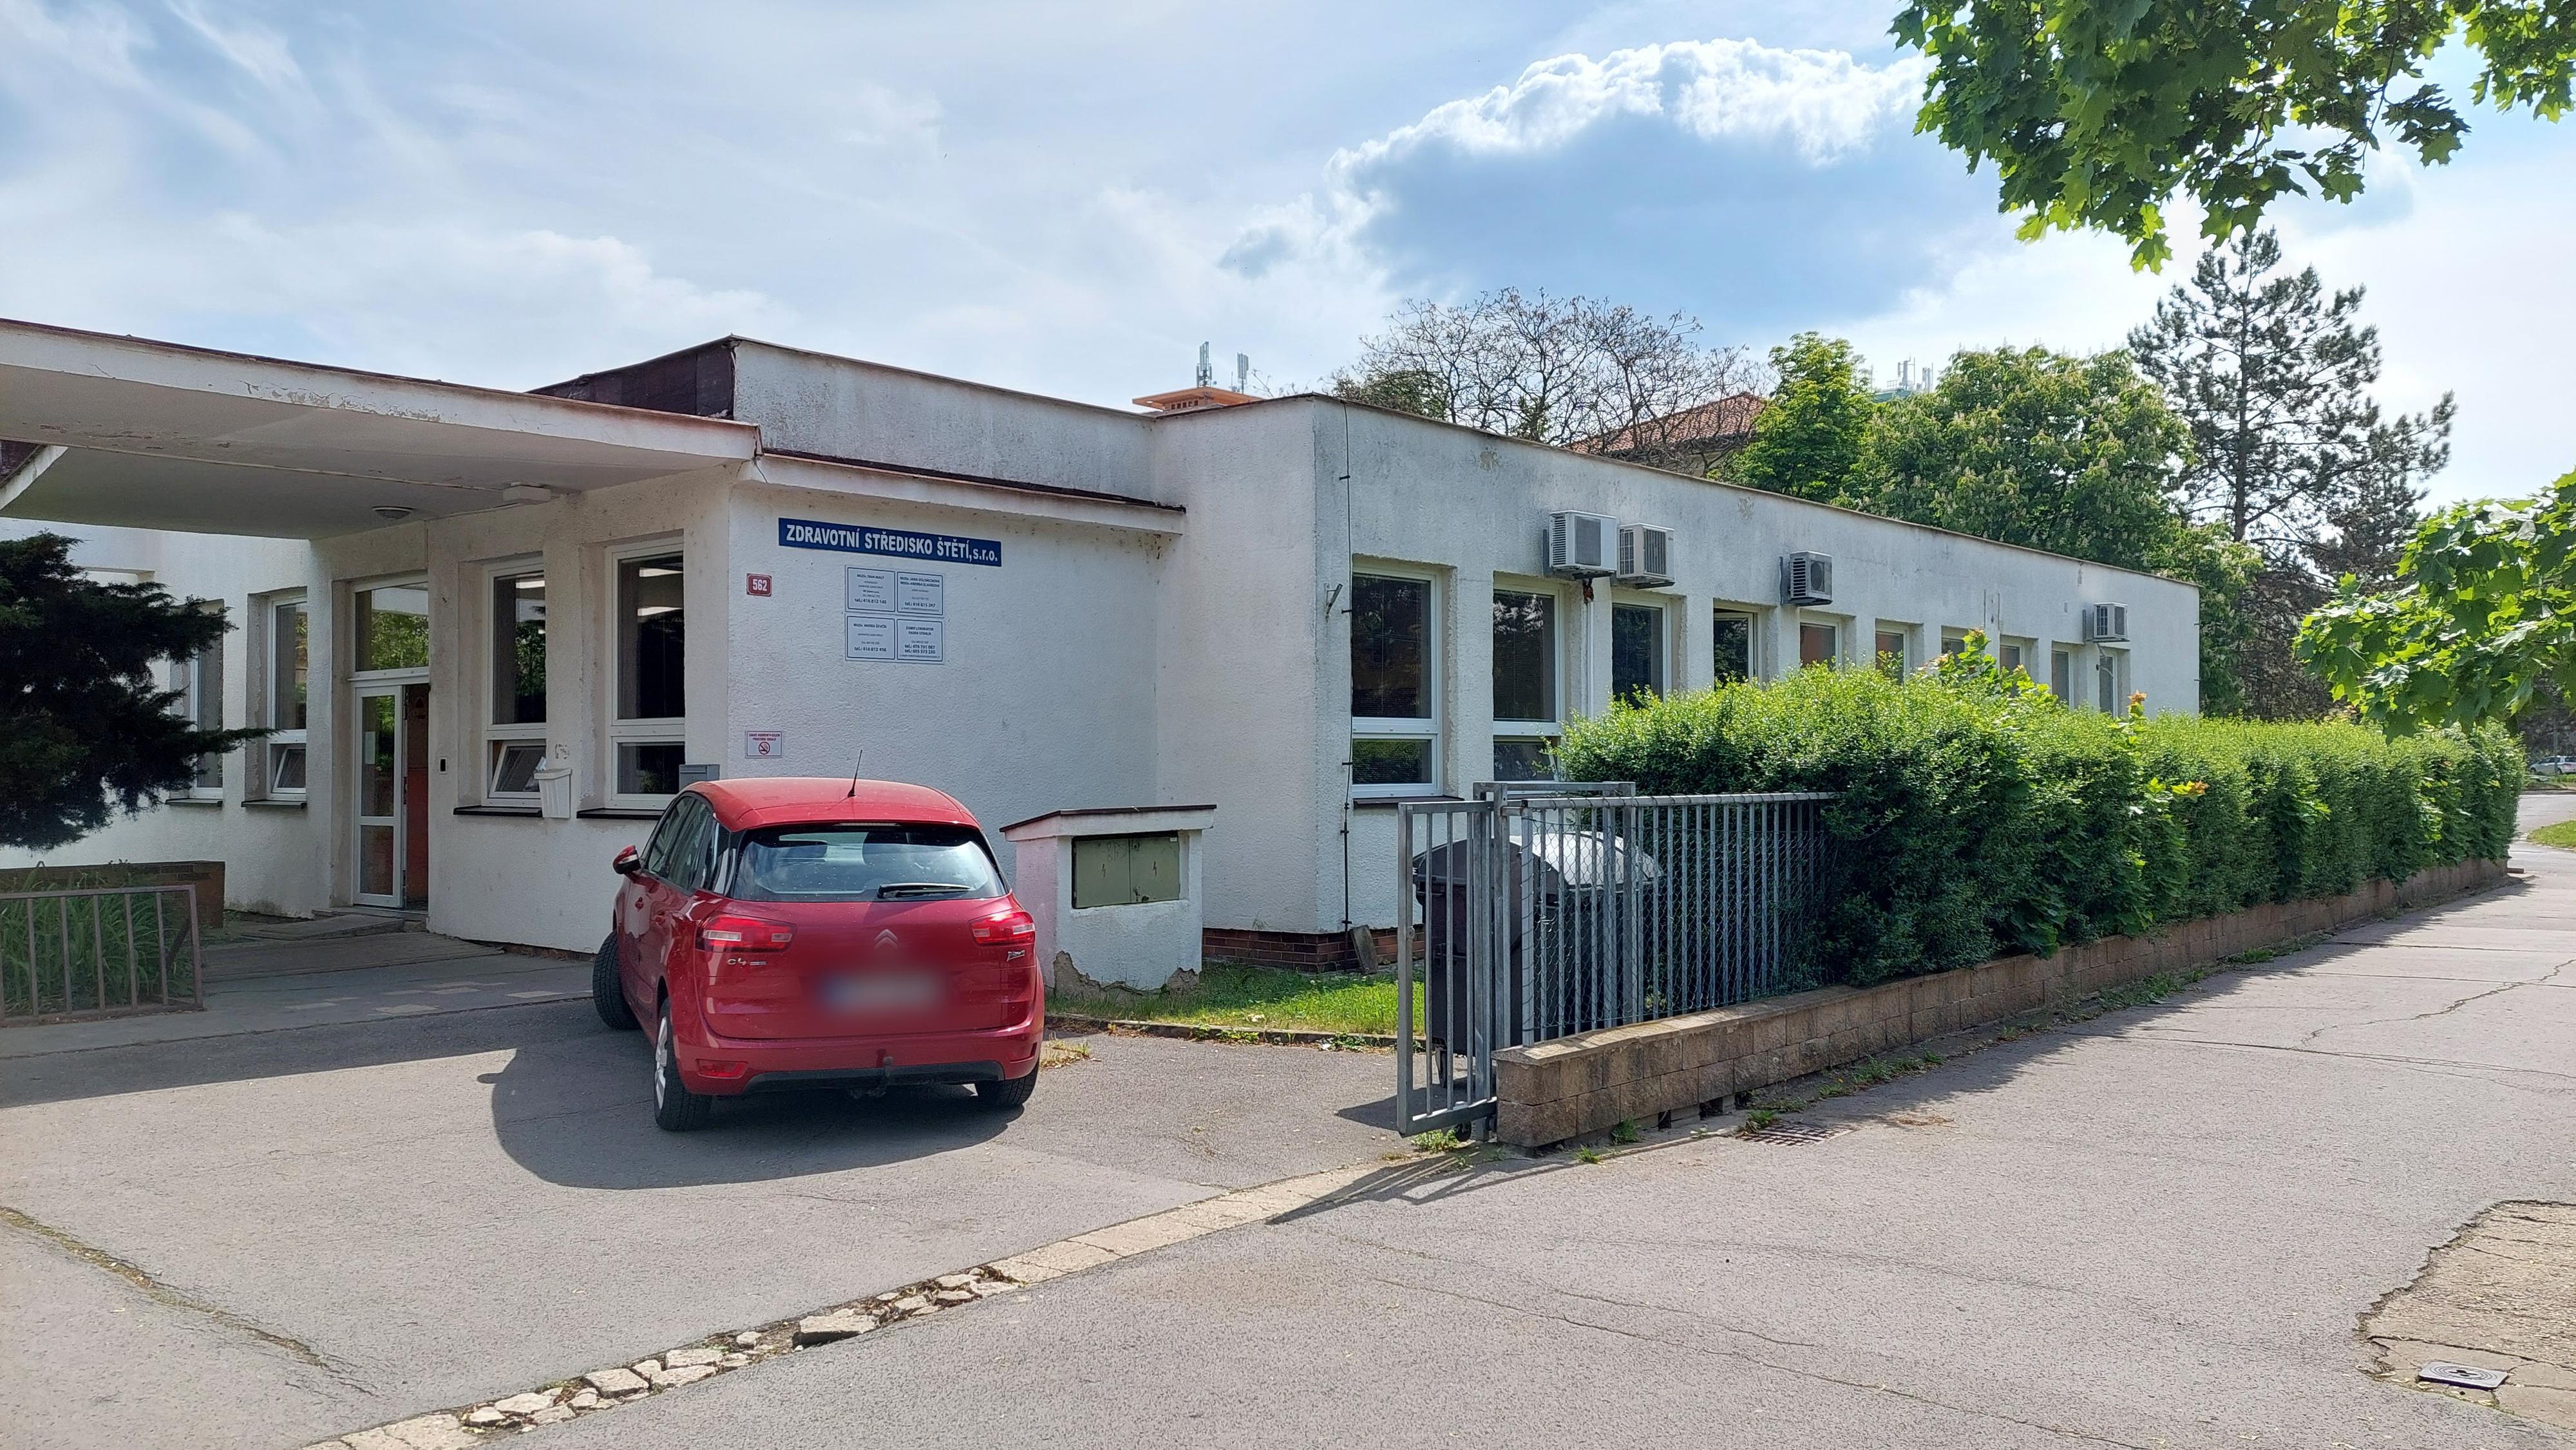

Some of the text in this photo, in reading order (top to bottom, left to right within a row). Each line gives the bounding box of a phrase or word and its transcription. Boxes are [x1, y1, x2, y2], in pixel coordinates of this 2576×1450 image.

[786, 524, 860, 547] ZDRAVOTNÍ
[865, 531, 933, 555] STŘEDISKO
[752, 578, 768, 592] 562
[727, 957, 747, 966] C4
